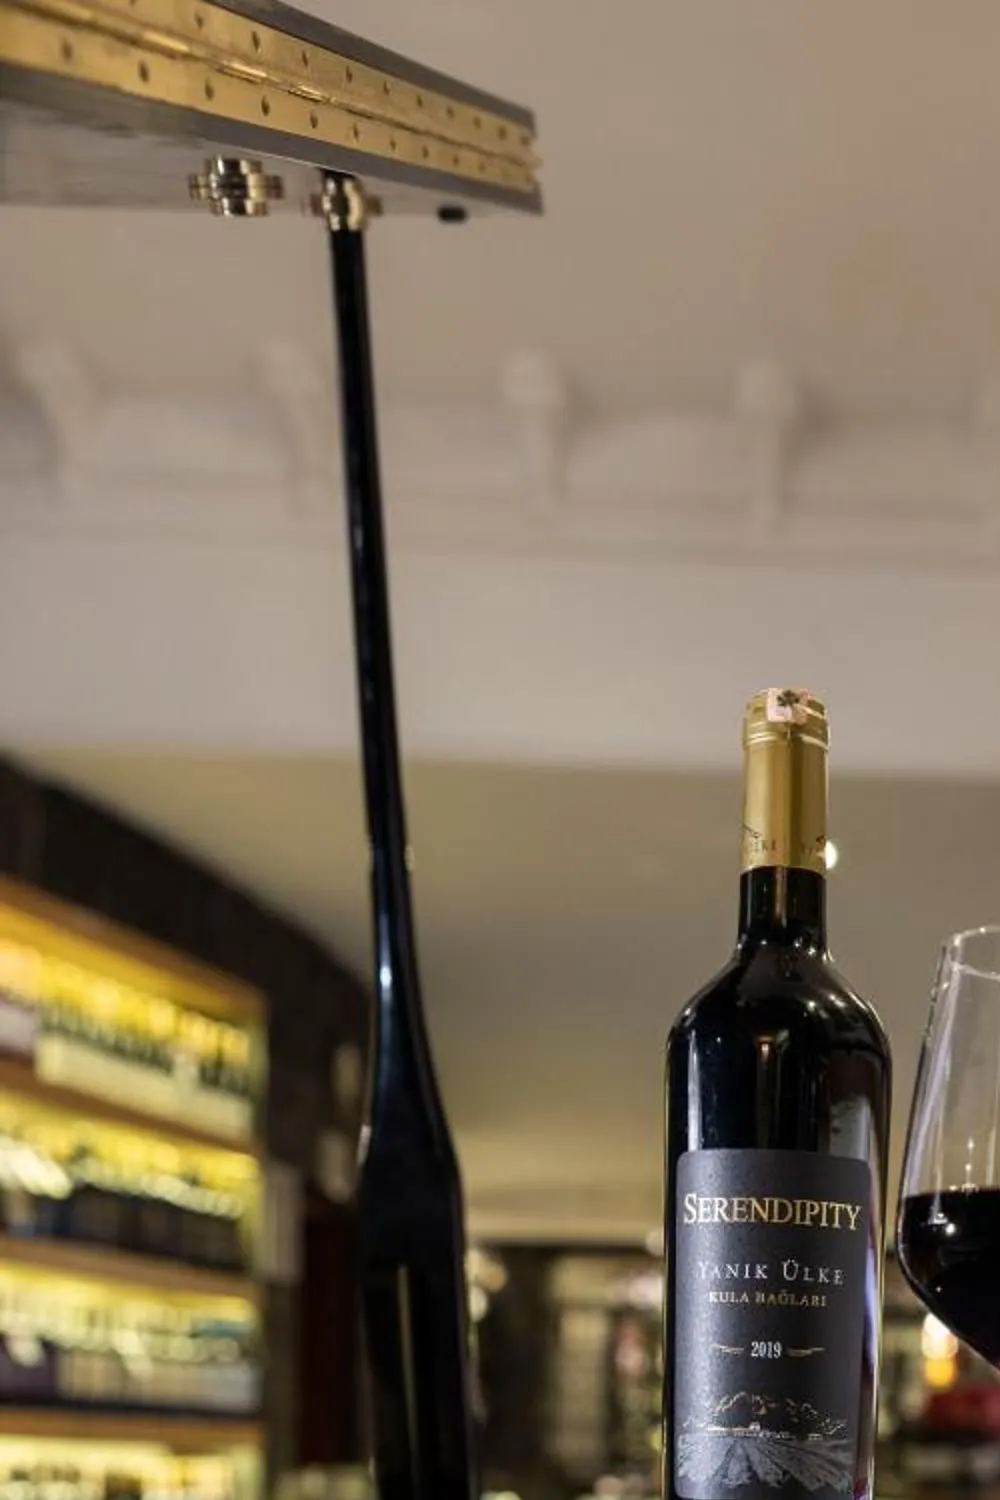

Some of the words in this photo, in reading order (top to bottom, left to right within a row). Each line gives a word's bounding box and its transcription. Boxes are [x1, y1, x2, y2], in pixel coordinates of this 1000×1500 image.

[683, 1193, 862, 1231] SERENDIPITY
[697, 1260, 769, 1280] YANIK
[782, 1259, 844, 1285] ÜLKE
[709, 1290, 750, 1304] KULA
[750, 1341, 783, 1359] 2019
